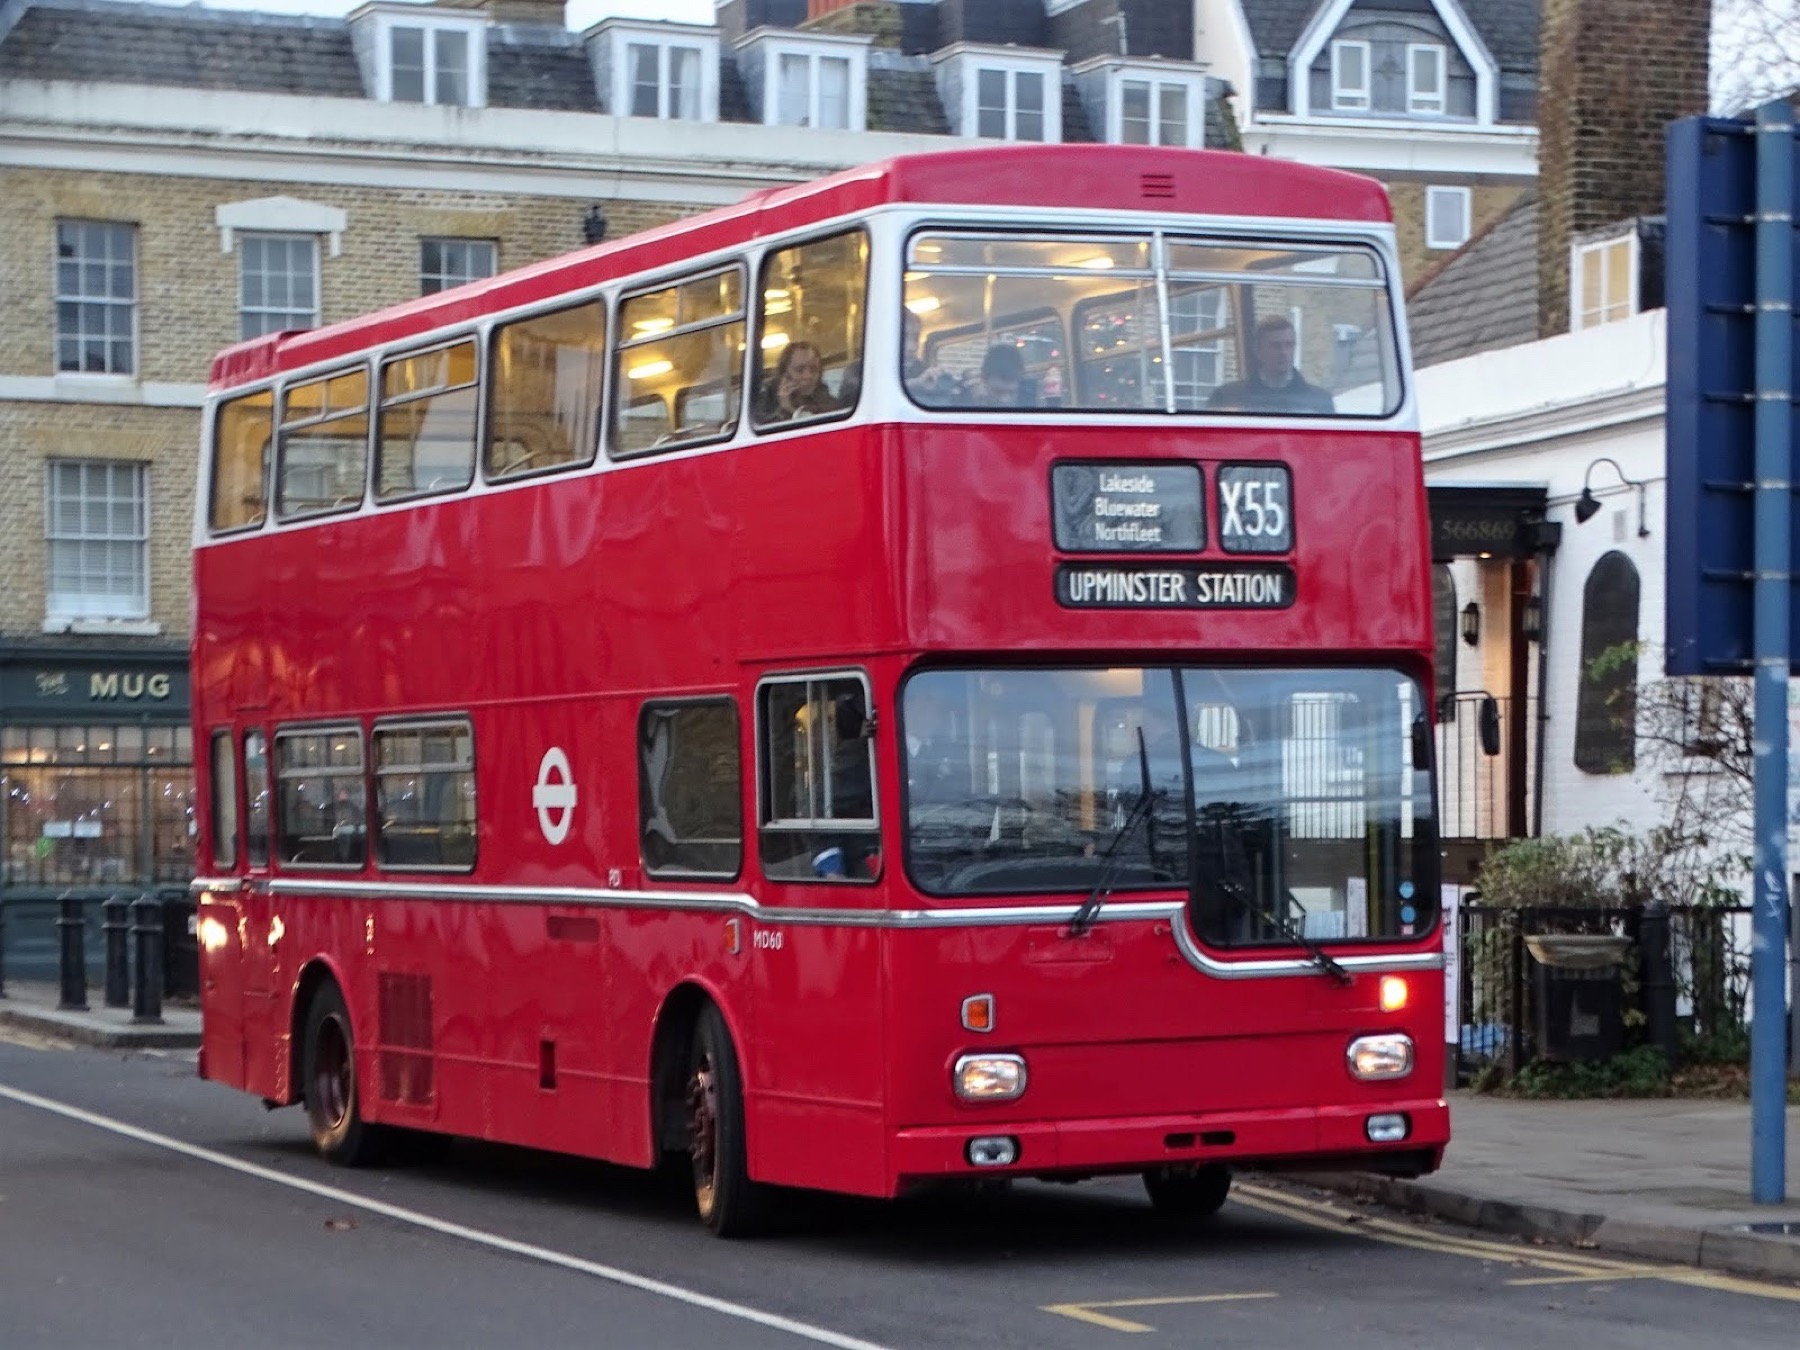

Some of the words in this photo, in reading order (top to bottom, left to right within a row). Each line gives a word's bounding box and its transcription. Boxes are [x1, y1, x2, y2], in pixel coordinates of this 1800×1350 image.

[1100, 474, 1155, 494] Lakeside
[1095, 497, 1161, 518] Bluewater
[1219, 480, 1286, 537] X55
[1095, 523, 1162, 542] Northfleet
[1069, 571, 1187, 602] UPMINSTER
[1197, 572, 1282, 603] STATION
[90, 672, 170, 698] MUG
[753, 929, 784, 950] MD60
